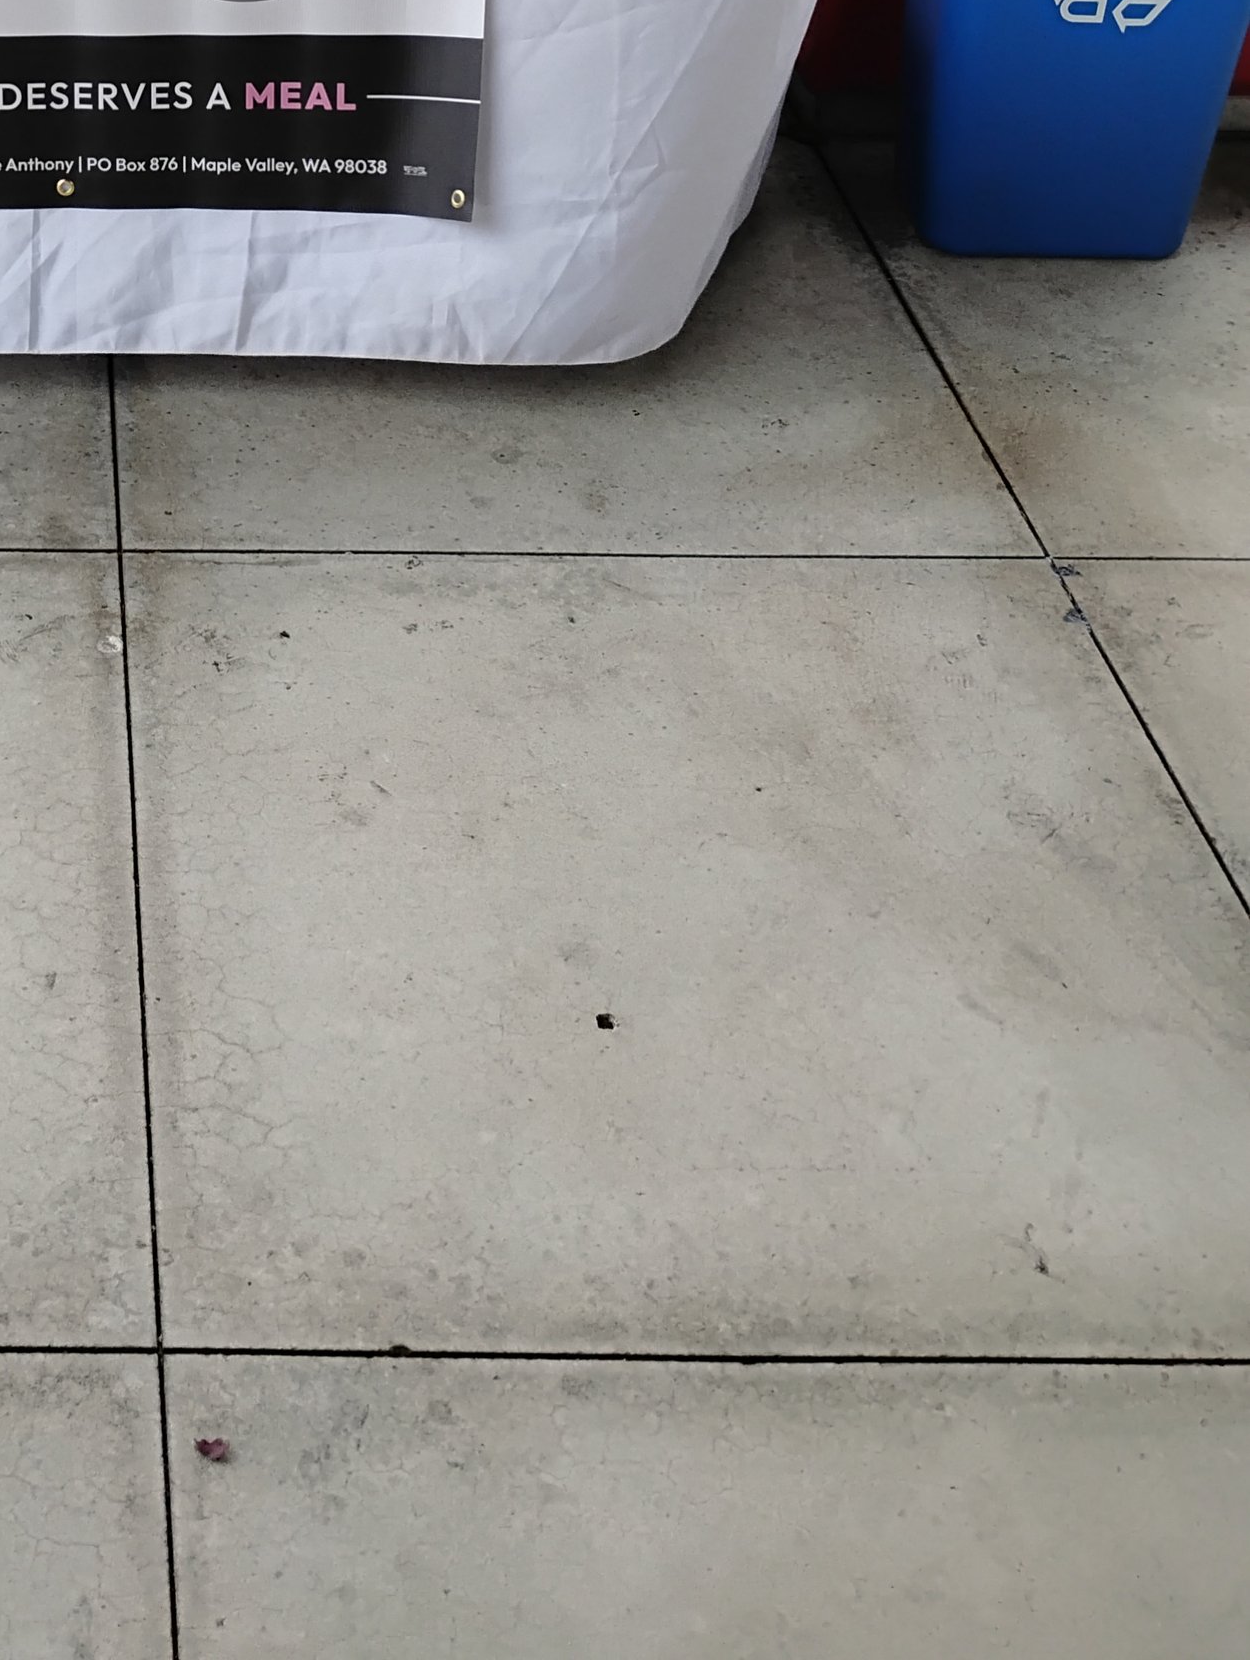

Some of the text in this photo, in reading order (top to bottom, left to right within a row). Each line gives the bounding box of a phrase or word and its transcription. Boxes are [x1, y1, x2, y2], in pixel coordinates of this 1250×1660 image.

[206, 83, 231, 110] A
[245, 82, 357, 111] MEAL
[5, 157, 74, 176] Anthony
[86, 157, 112, 172] PO
[115, 158, 146, 172] Box
[149, 157, 178, 172] 876
[191, 157, 242, 175] Maple
[245, 157, 298, 176] Valley,
[302, 158, 331, 173] WA
[334, 158, 387, 174] 98038
